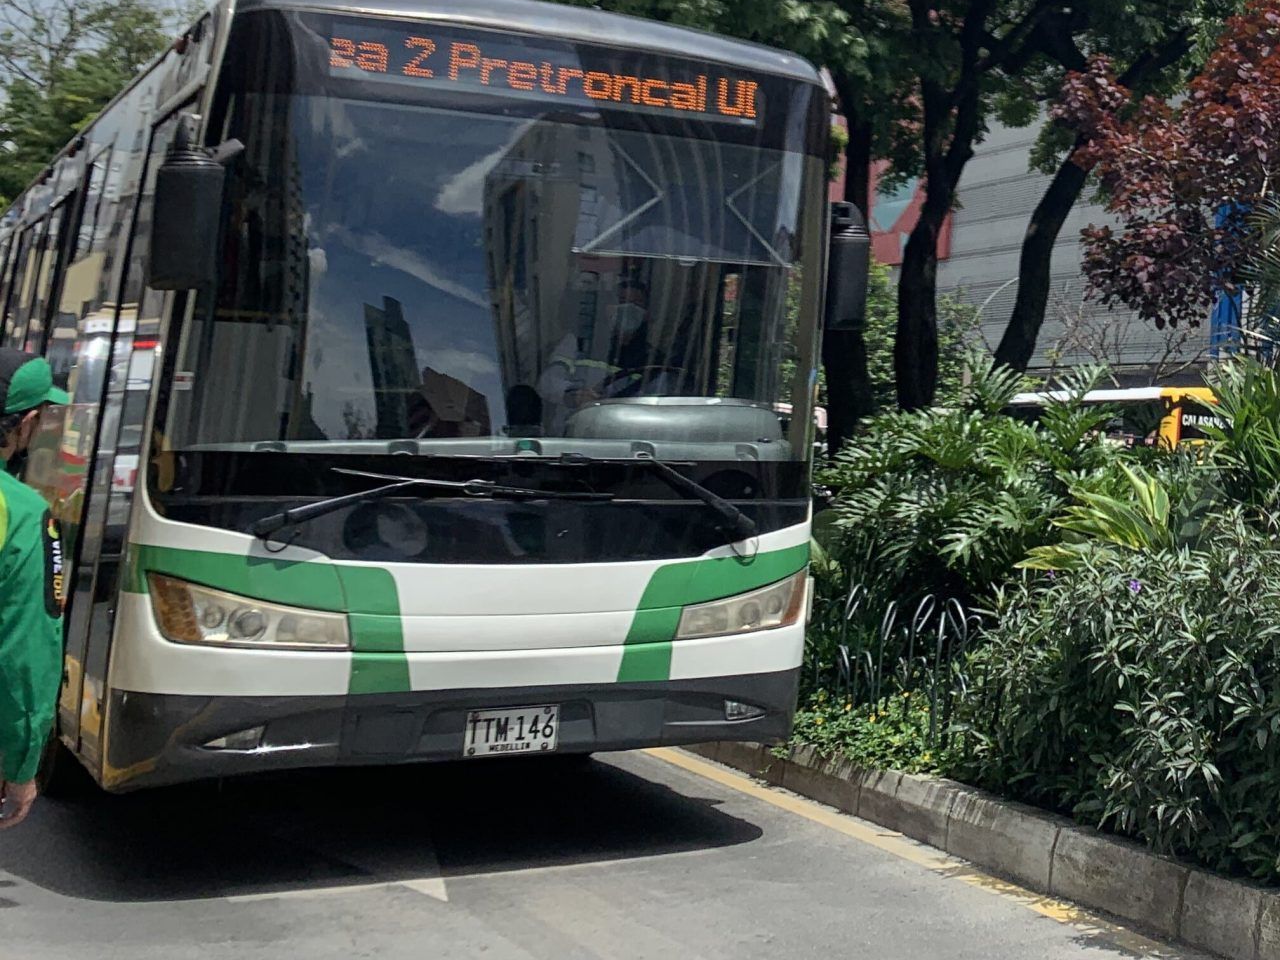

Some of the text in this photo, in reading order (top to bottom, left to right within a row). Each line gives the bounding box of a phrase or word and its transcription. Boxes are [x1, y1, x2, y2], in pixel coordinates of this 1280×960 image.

[402, 36, 436, 78] 2
[449, 41, 706, 113] Pretroncal
[469, 713, 555, 745] TTM-146
[488, 742, 531, 752] MEDELLIN
